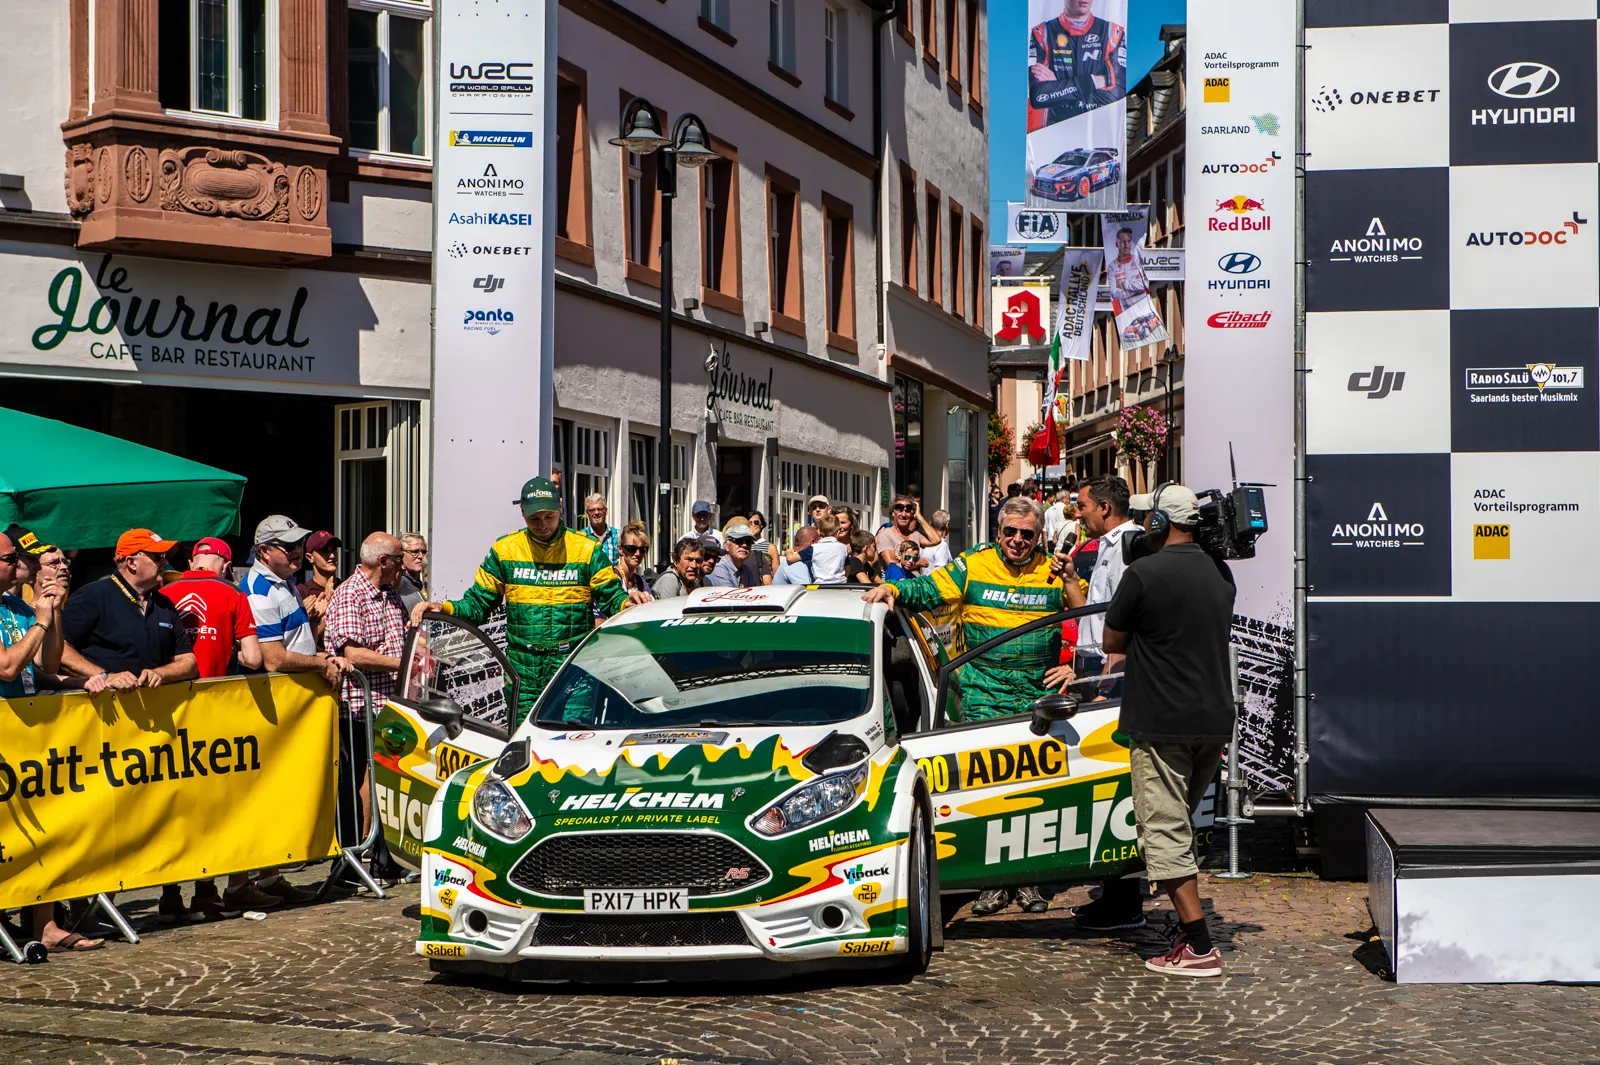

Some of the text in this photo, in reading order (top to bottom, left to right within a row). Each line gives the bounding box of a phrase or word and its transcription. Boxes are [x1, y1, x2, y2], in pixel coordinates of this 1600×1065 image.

[450, 62, 533, 80] WRC
[1204, 60, 1279, 70] Vorteilsprogramm
[1205, 77, 1229, 87] ADAC
[1350, 90, 1440, 105] ONEBET
[1472, 107, 1575, 125] HYUNDAI
[1201, 126, 1250, 135] SAARLAND
[1202, 164, 1268, 174] AUTODOC
[457, 180, 524, 189] ANONIMO
[1208, 216, 1270, 231] Red Bull
[1330, 237, 1422, 253] ANONIMO
[1466, 231, 1567, 247] AUTODOC
[472, 246, 531, 256] ONEBET
[1144, 257, 1180, 265] WRC
[1354, 255, 1398, 263] WATCHES
[95, 253, 133, 293] le
[1208, 280, 1270, 289] HYUNDAI
[32, 266, 310, 351] Journal
[1063, 265, 1083, 339] ADAC RALLYE
[1074, 276, 1090, 337] DEUTSCHLAND
[464, 308, 514, 324] panta
[1207, 311, 1272, 328] Eibach
[90, 342, 316, 373] CAFE BAR RESTAURANT
[722, 341, 731, 371] le
[706, 350, 774, 411] Journal
[1552, 372, 1578, 384] 101,7
[1471, 392, 1578, 403] Saarlands bester Musikmix
[719, 409, 774, 432] CAFE BAR RESTAURANT
[1474, 489, 1506, 499] ADAC
[1474, 502, 1579, 513] Vorteilsprogramm
[1332, 523, 1424, 537] ANONIMO
[1475, 526, 1509, 537] ADAC
[1356, 540, 1400, 548] WATCHES
[514, 566, 578, 584] HELICHEM
[982, 588, 1048, 606] HELICHEM
[660, 615, 798, 628] HELICHEM
[966, 740, 1062, 786] ADAC
[558, 787, 724, 811] HELICHEM
[554, 815, 618, 826] SPECIALIST
[635, 814, 683, 823] PRIVATE
[687, 814, 720, 824] LABEL
[452, 836, 487, 858] HELICHEM
[809, 829, 870, 852] HELICHEM
[434, 869, 467, 886] Vipack
[725, 867, 750, 879] RS
[843, 864, 889, 884] Vipack
[440, 896, 452, 908] ncp
[591, 892, 681, 910] PX17 HPK
[858, 892, 876, 903] ncp
[426, 944, 462, 957] Sabelt
[842, 941, 891, 954] Sabelt
